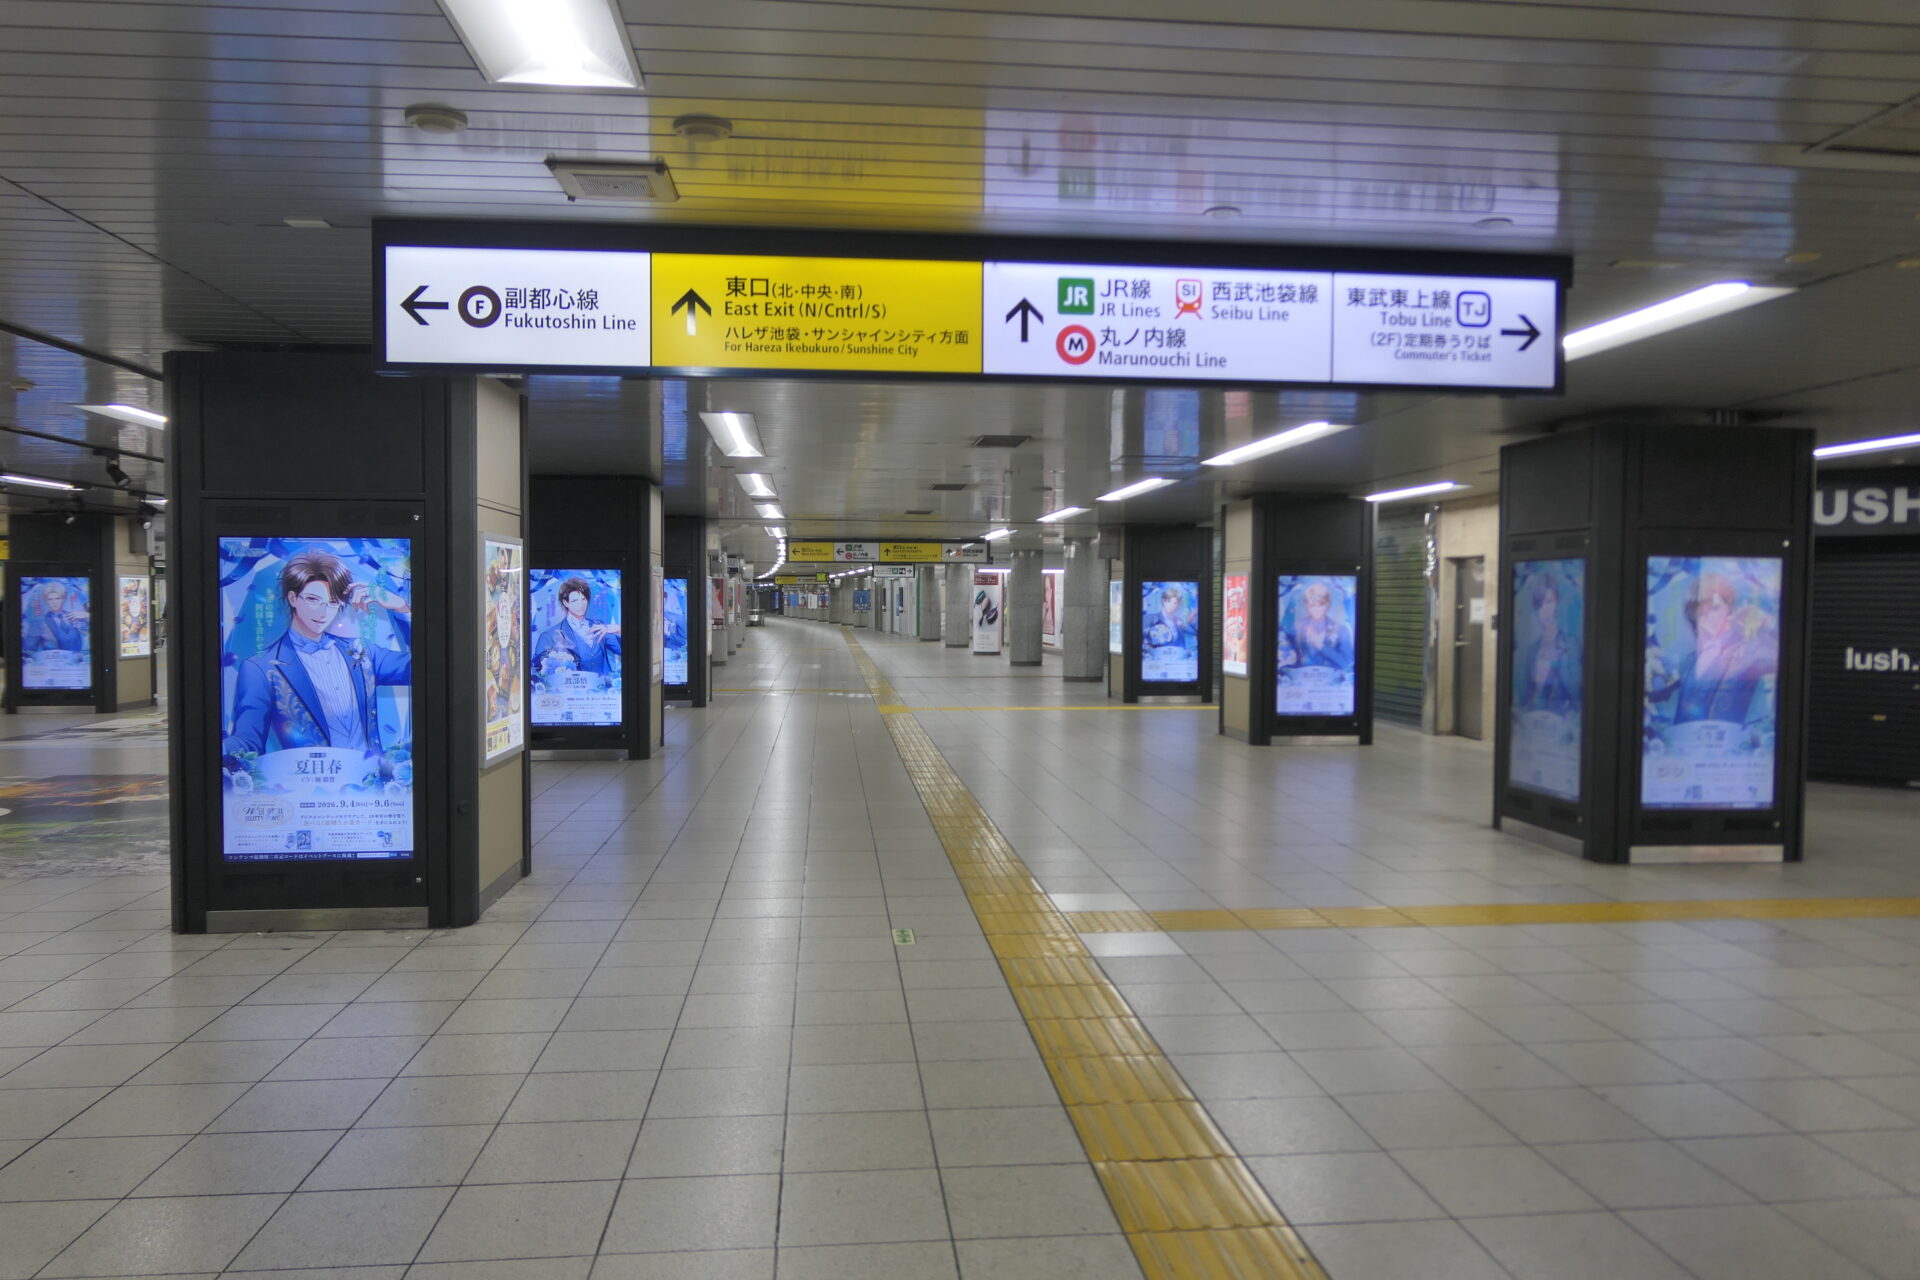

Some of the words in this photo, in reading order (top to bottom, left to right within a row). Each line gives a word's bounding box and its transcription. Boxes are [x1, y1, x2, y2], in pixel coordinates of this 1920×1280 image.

[1063, 287, 1089, 306] JR
[1100, 279, 1151, 300] JR線
[1182, 284, 1196, 296] SI
[1212, 282, 1319, 304] 西武池袋線
[505, 287, 599, 310] 副都心線
[1347, 288, 1451, 309] 東武東上線
[475, 299, 484, 315] F
[725, 301, 758, 316] East
[765, 302, 795, 317] Exit
[799, 303, 887, 319] (N/Cntrl/S)
[1100, 304, 1116, 317] JR
[1122, 305, 1160, 318] Lines
[1211, 306, 1253, 321] Seibu
[1259, 307, 1289, 321] Line
[1463, 302, 1486, 317] TJ
[505, 313, 596, 330] Fukutoshin
[603, 315, 636, 331] Line
[1381, 311, 1417, 327] Tobu
[1422, 313, 1452, 327] Line
[725, 327, 969, 345] ハレザ池袋・サンシャインシティ方面
[1068, 337, 1084, 351] M
[1100, 327, 1187, 348] 丸ノ内線
[725, 342, 742, 352] For
[745, 343, 782, 353] Hareza
[897, 345, 918, 358] City
[1461, 350, 1492, 361] Ticket
[1098, 351, 1190, 367] Marunouchi
[1196, 353, 1227, 368] Line
[295, 759, 342, 774] 夏目春
